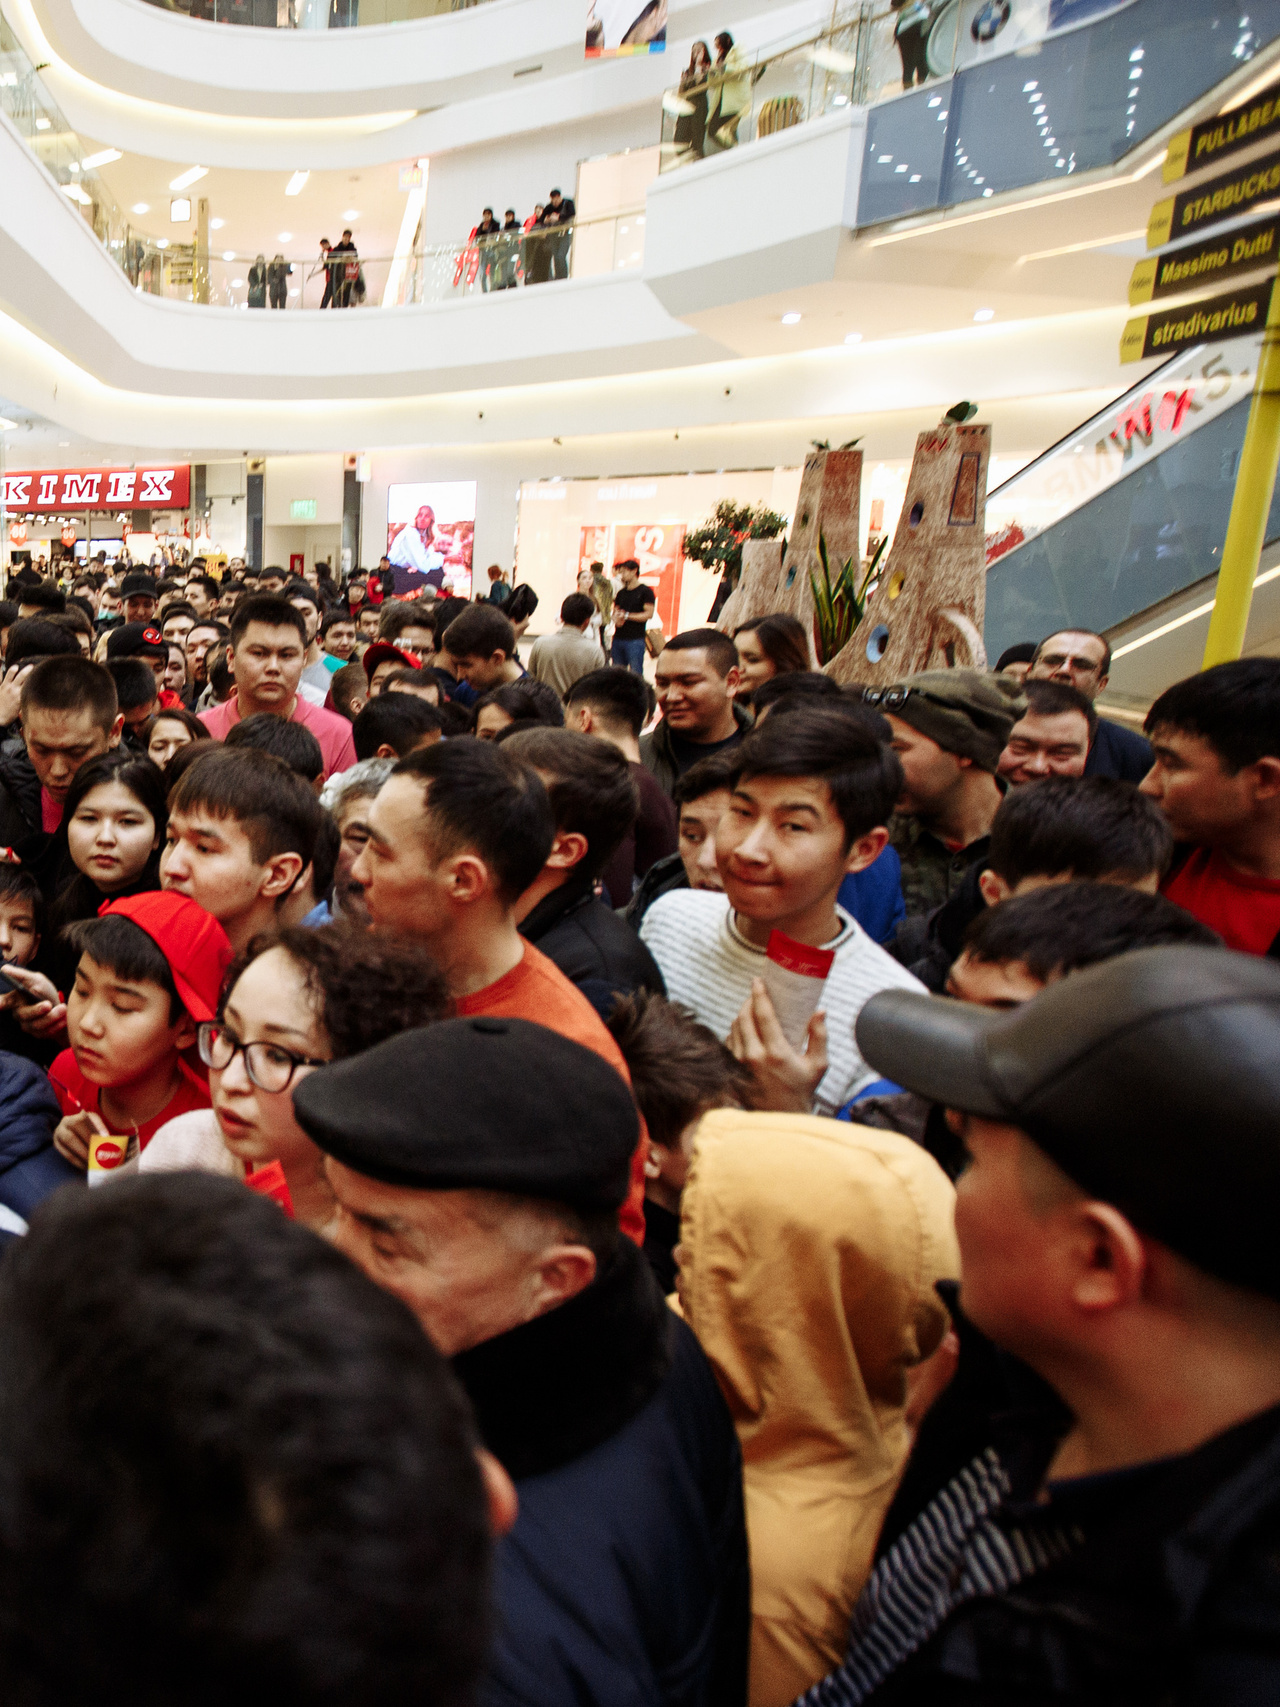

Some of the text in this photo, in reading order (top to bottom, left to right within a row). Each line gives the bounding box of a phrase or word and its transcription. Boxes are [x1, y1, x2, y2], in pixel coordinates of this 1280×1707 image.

[1160, 247, 1229, 285] Massimo
[1231, 228, 1275, 263] Dutti
[1152, 300, 1258, 347] stradivarius
